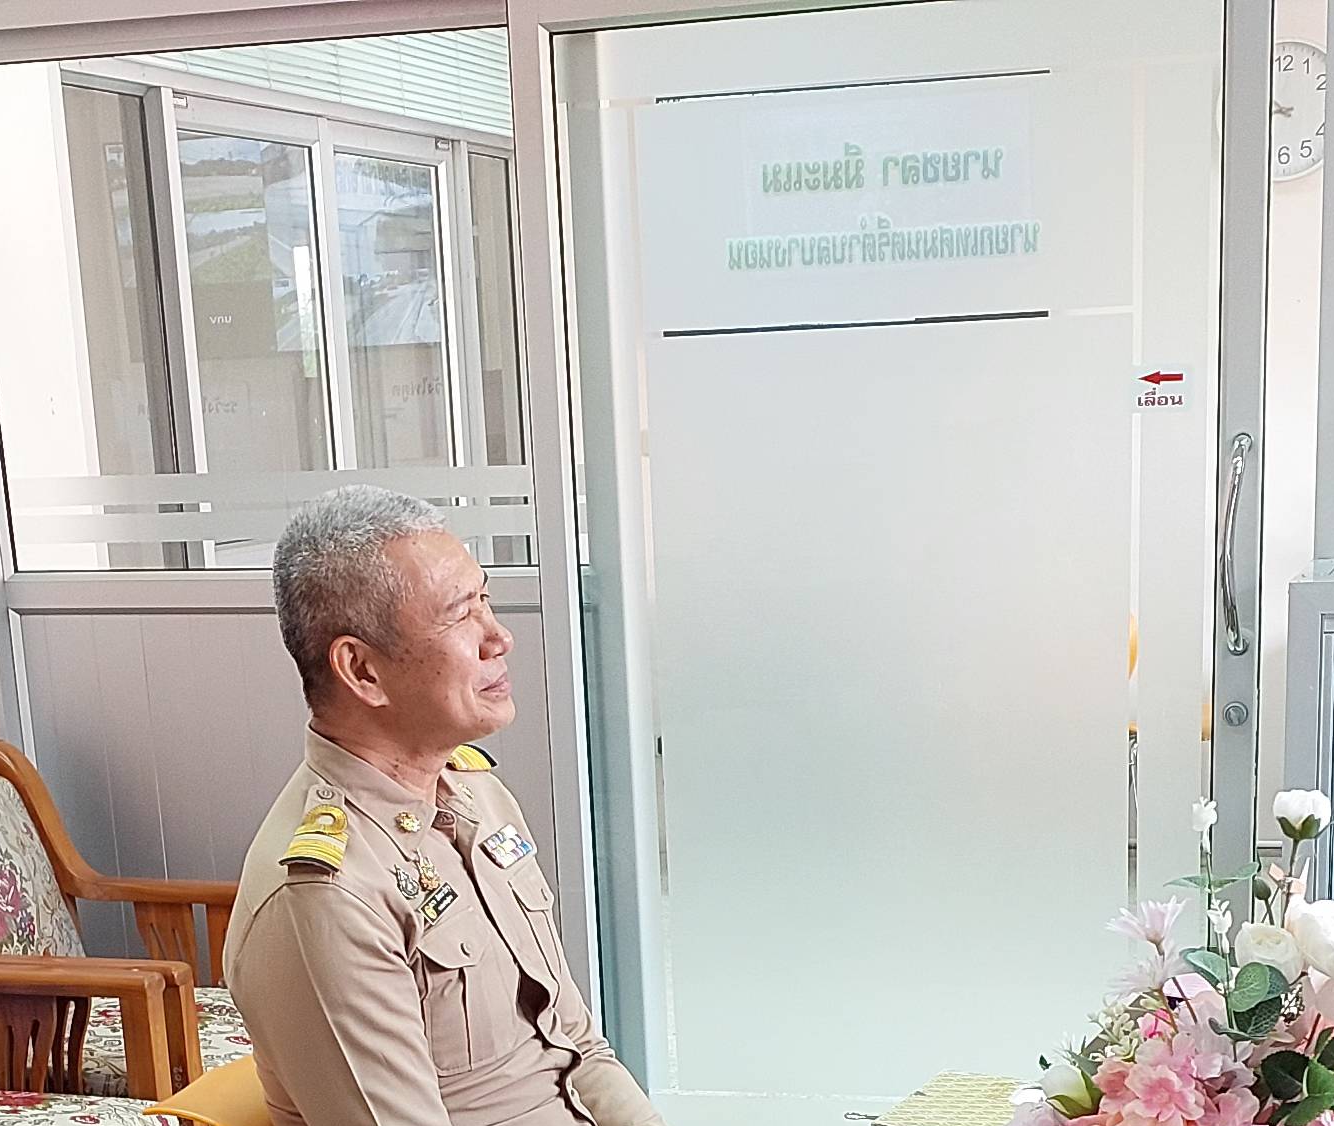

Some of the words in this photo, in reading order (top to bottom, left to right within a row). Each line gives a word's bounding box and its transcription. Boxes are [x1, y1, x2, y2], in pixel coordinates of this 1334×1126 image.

[1274, 55, 1294, 72] 12
[1303, 58, 1310, 74] 1
[1278, 146, 1290, 164] 6
[1300, 140, 1312, 158] 5
[1137, 387, 1183, 407] เลื่อน
